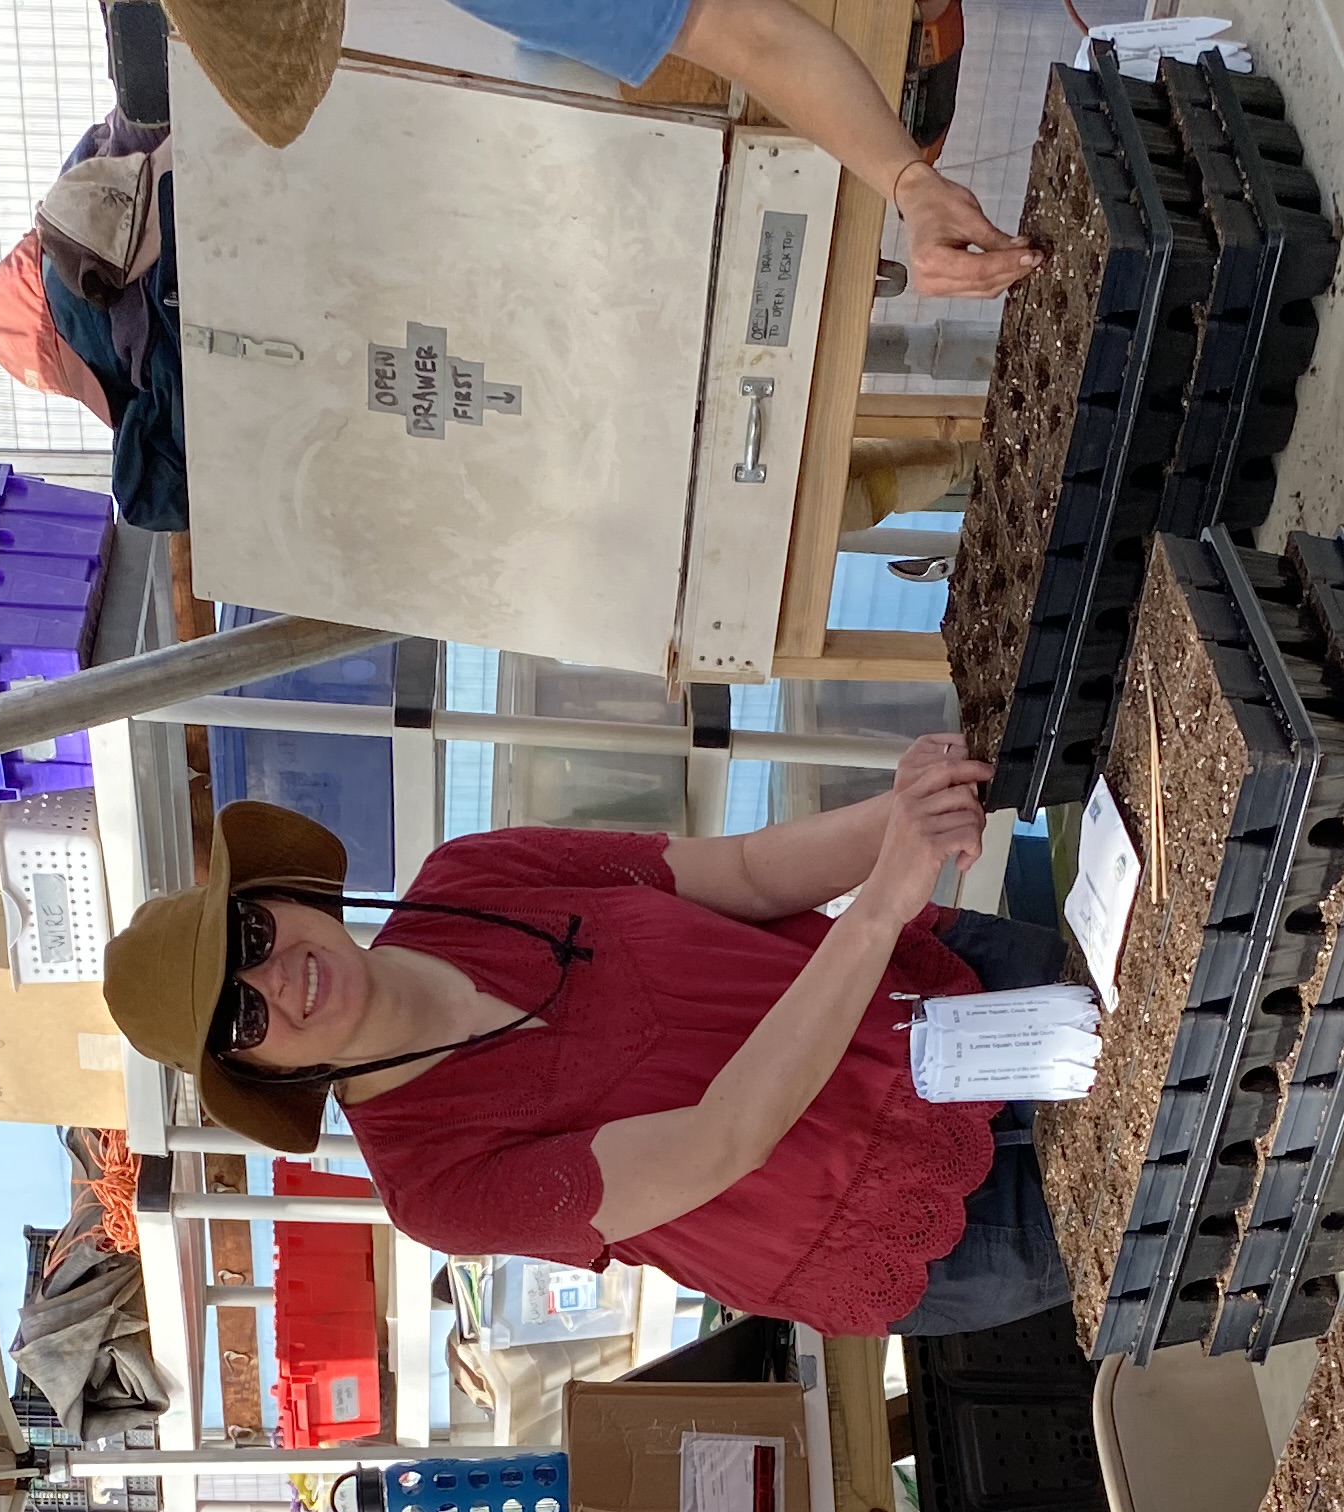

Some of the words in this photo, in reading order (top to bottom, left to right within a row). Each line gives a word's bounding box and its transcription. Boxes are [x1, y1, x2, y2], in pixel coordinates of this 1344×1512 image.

[760, 230, 775, 274] DRAWER
[755, 280, 769, 305] THIS
[772, 287, 787, 318] OPEN
[750, 307, 765, 341] OPEN
[768, 324, 780, 339] TO
[374, 350, 399, 407] OPEN
[412, 344, 439, 431] DRAWER
[451, 364, 474, 420] FIRST
[40, 904, 67, 951] WIRE
